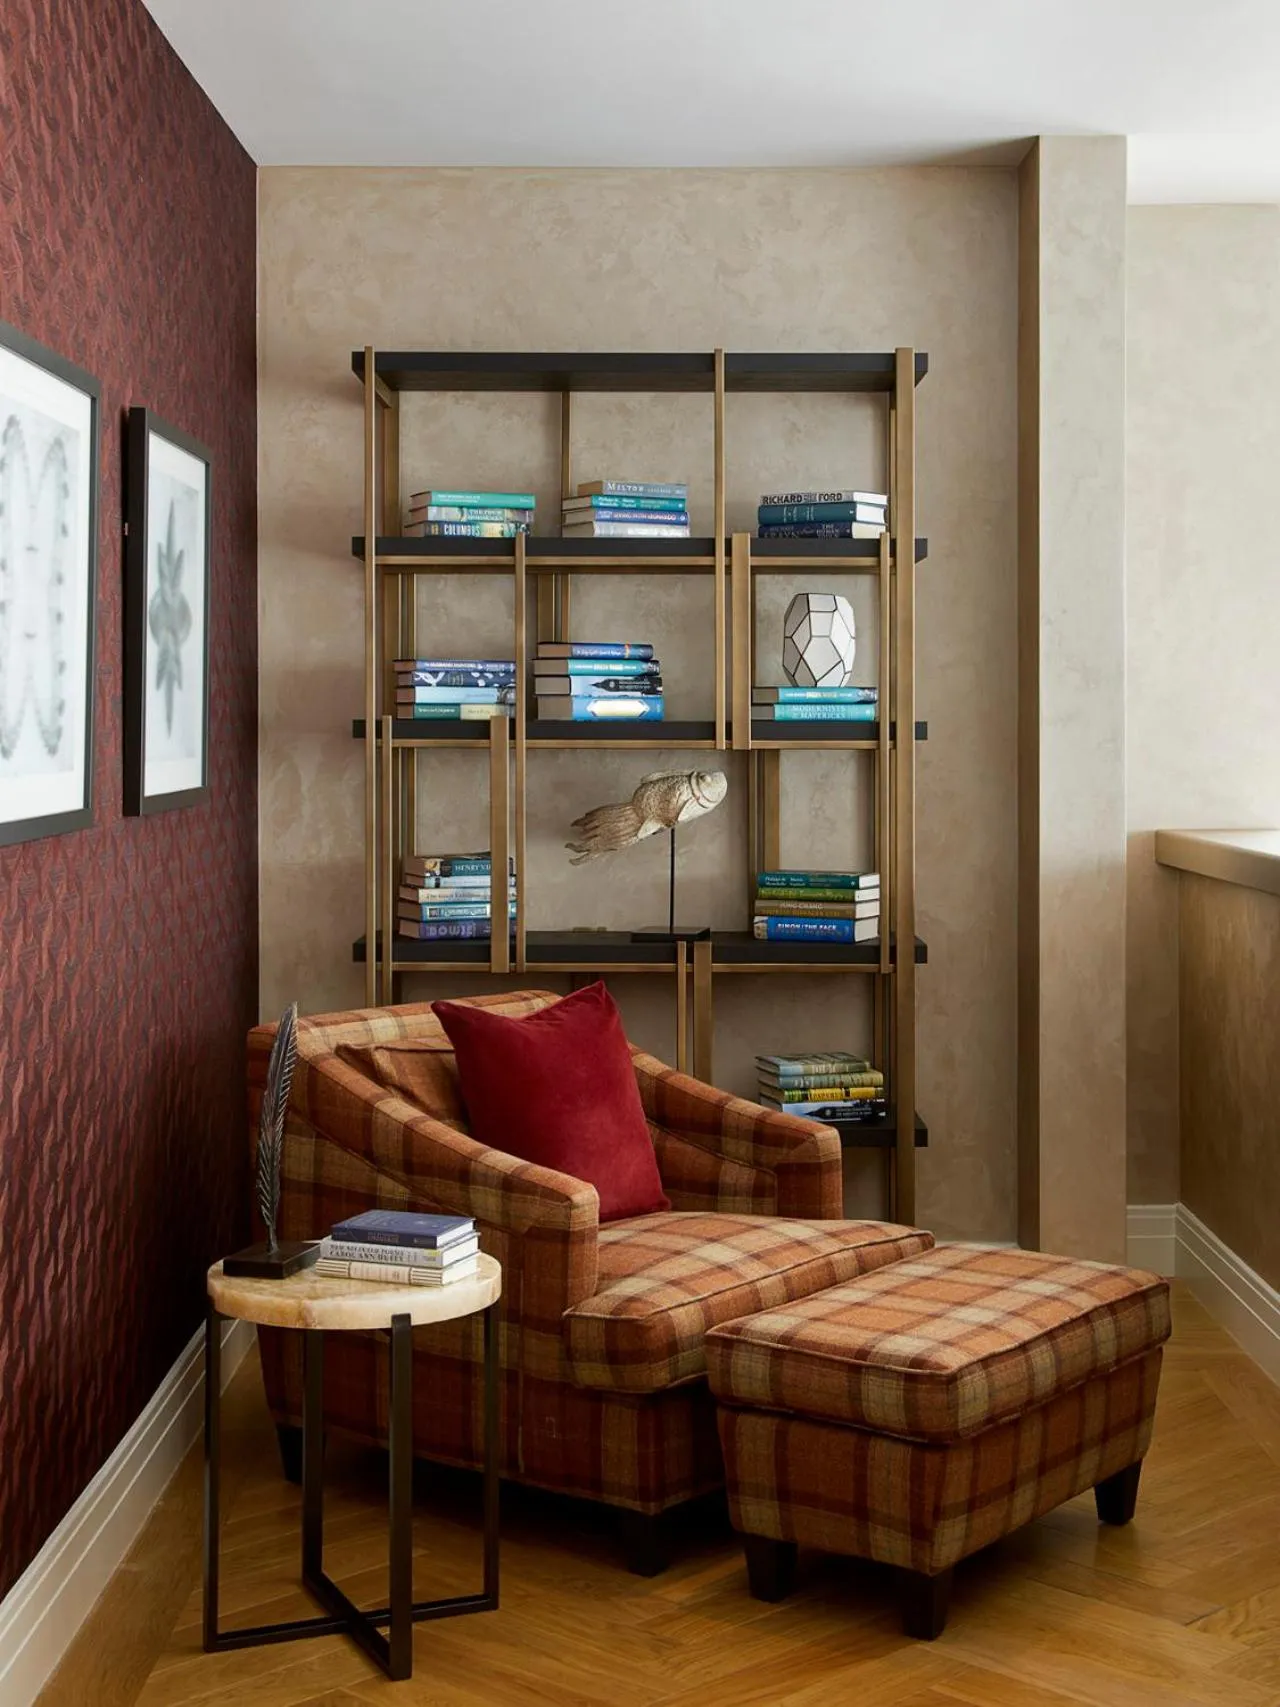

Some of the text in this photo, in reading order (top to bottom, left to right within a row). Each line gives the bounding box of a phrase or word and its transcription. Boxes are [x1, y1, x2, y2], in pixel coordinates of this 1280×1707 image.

[762, 492, 843, 505] RICHARD FORD
[443, 523, 480, 536] COLUMBUS
